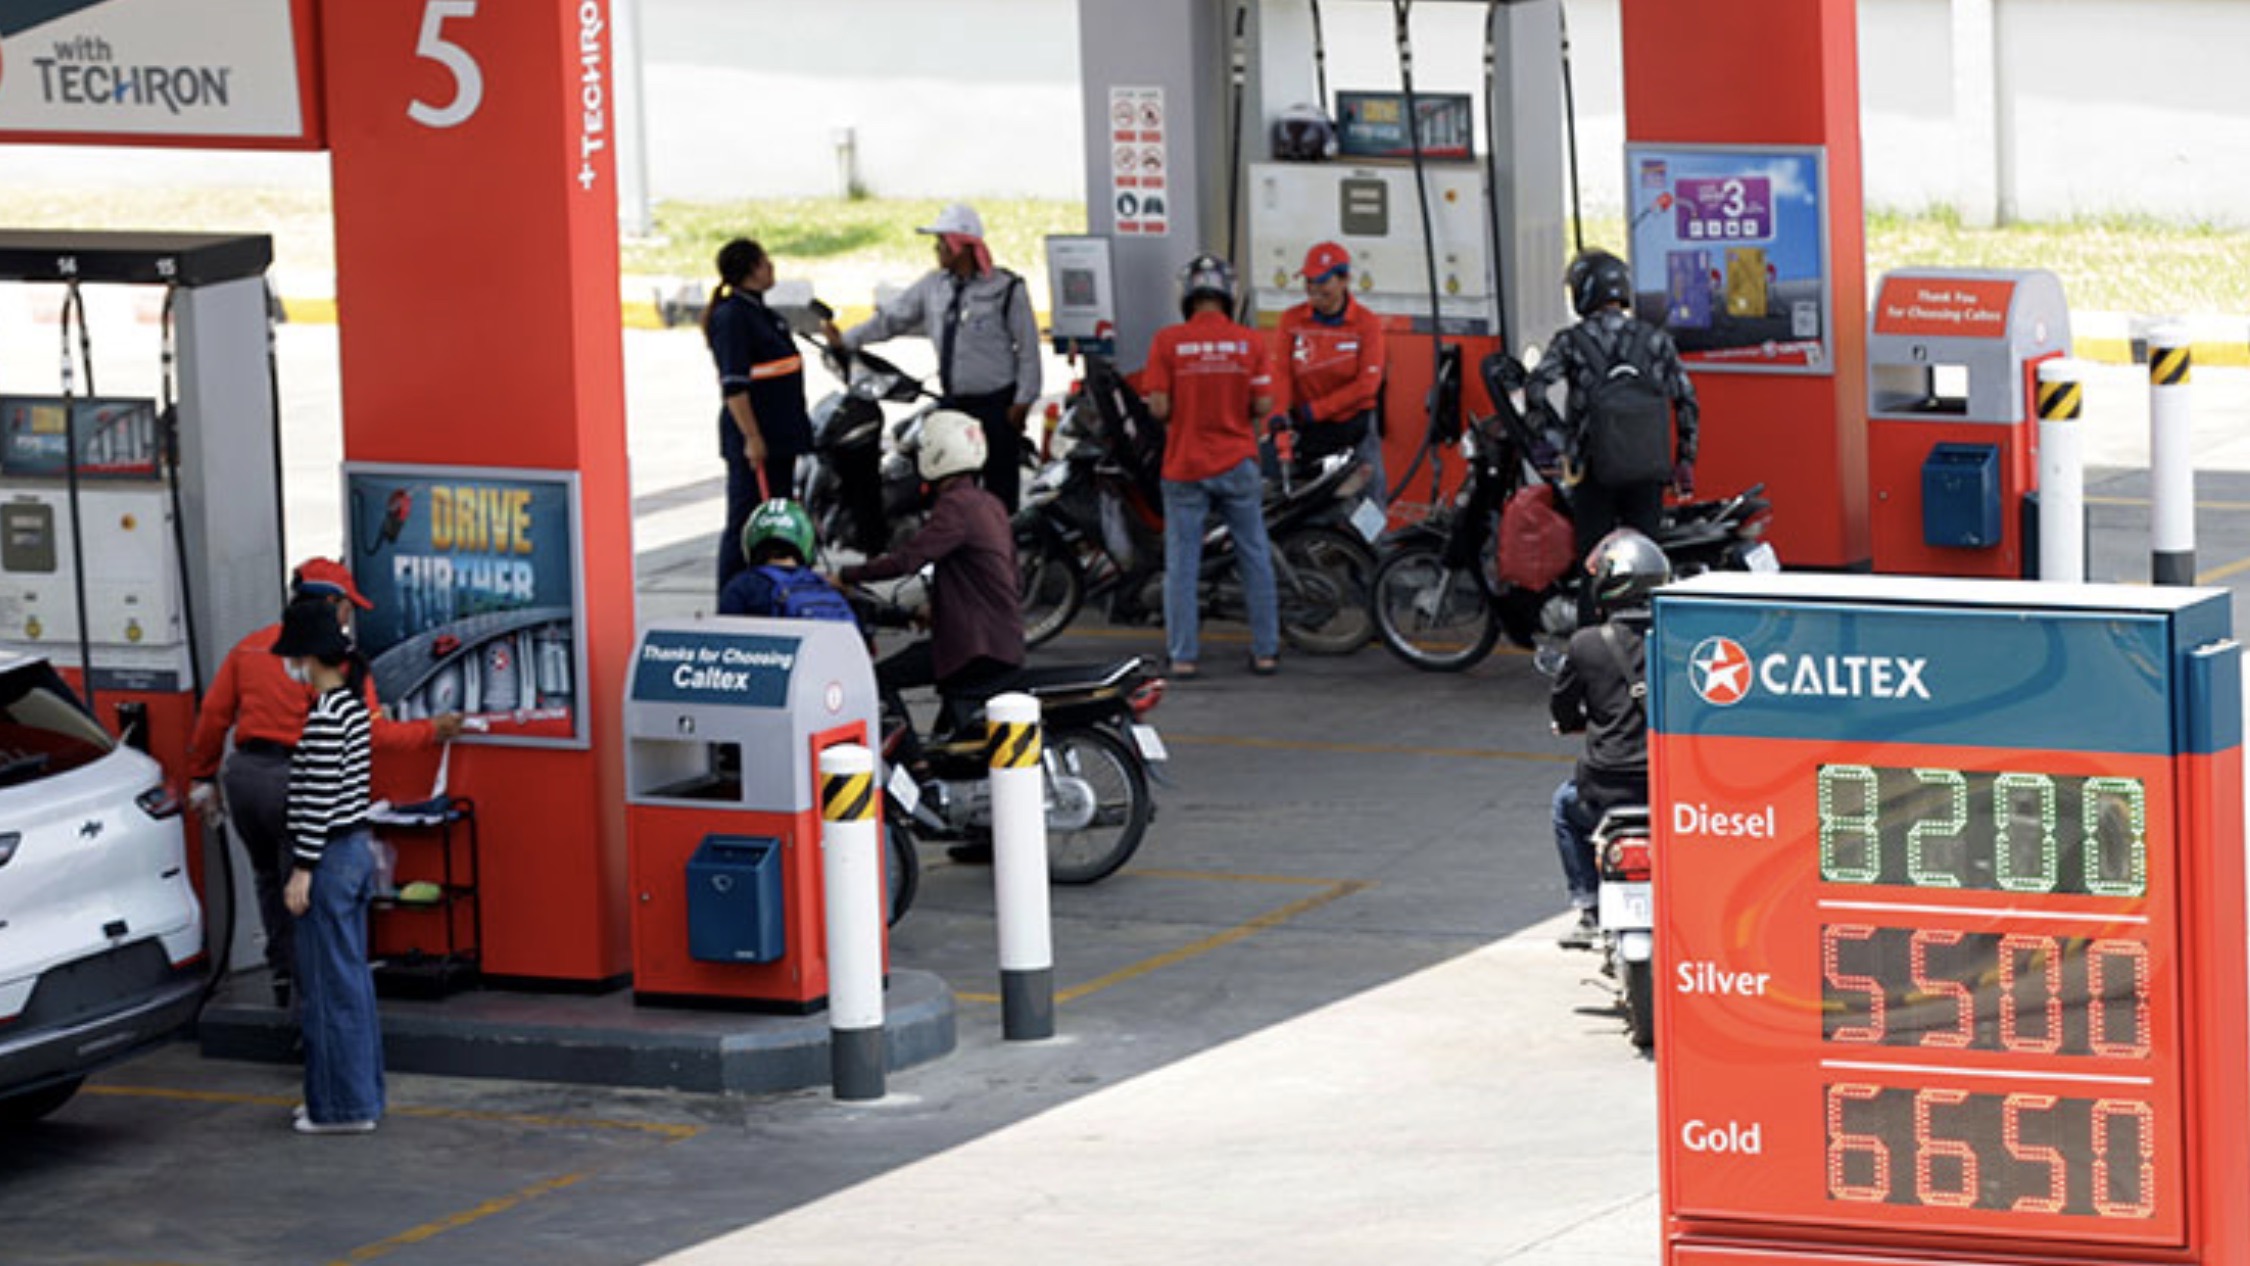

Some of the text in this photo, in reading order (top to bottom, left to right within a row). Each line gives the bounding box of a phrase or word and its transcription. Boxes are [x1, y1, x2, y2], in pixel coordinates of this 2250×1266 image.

[54, 35, 112, 61] with
[407, 0, 484, 128] 5
[33, 57, 228, 115] TECHRON
[1723, 179, 1745, 218] 3
[1918, 289, 1977, 304] Thank You
[431, 485, 532, 554] DRIVE
[644, 644, 793, 670] Thanks for Choosing
[672, 664, 749, 692] Caltex
[1760, 653, 1930, 699] CALTEX
[1673, 763, 2146, 897] Diesel 8200
[1677, 923, 2150, 1059] Silver 5500
[1681, 1083, 2154, 1218] Gold 6650
